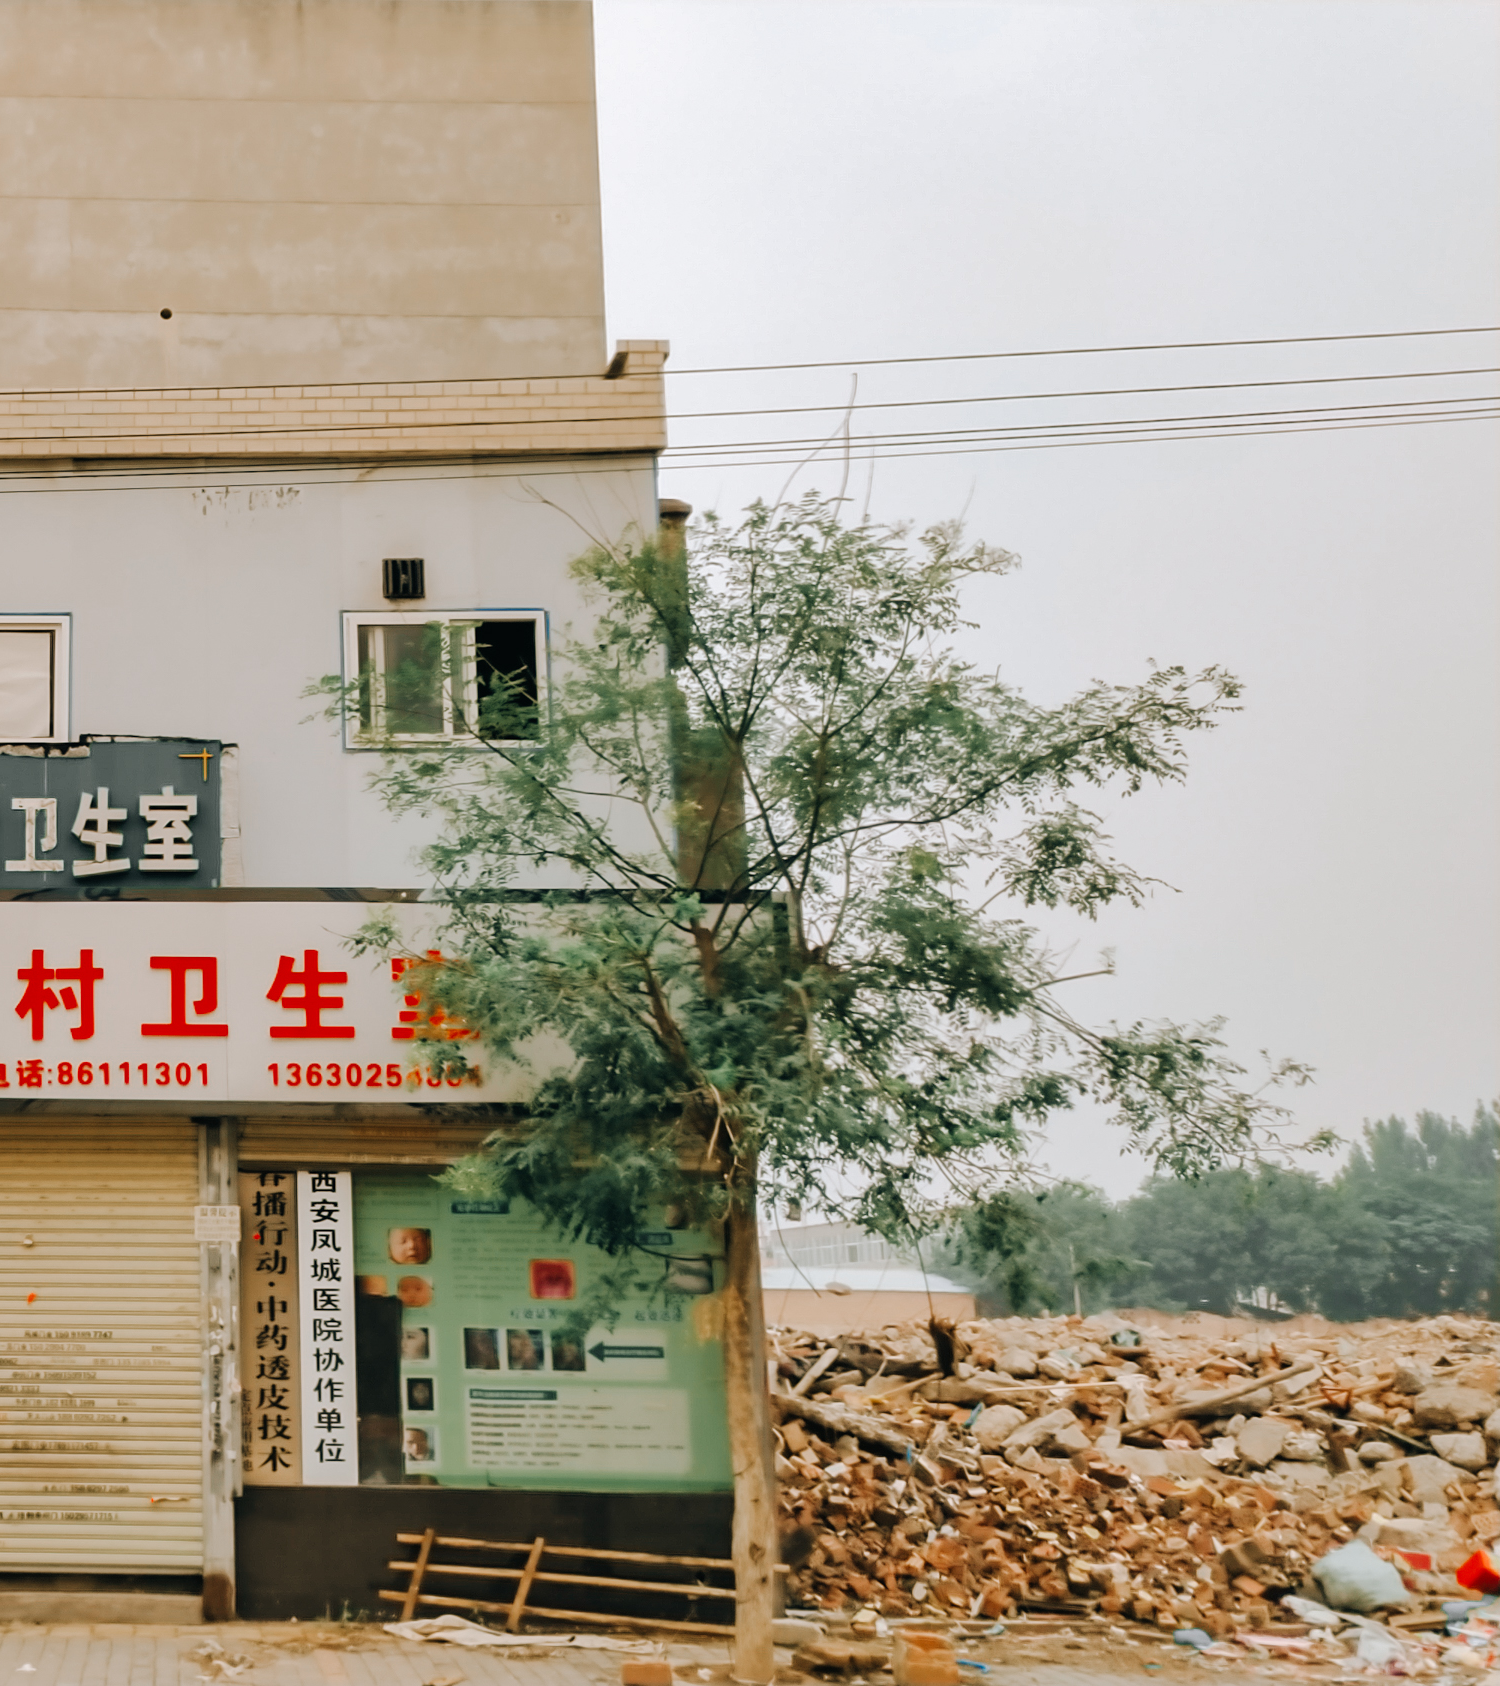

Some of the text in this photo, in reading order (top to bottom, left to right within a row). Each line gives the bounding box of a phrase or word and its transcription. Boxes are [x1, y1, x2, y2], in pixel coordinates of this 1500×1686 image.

[309, 1171, 347, 1464] 西安凤城医院协作单位
